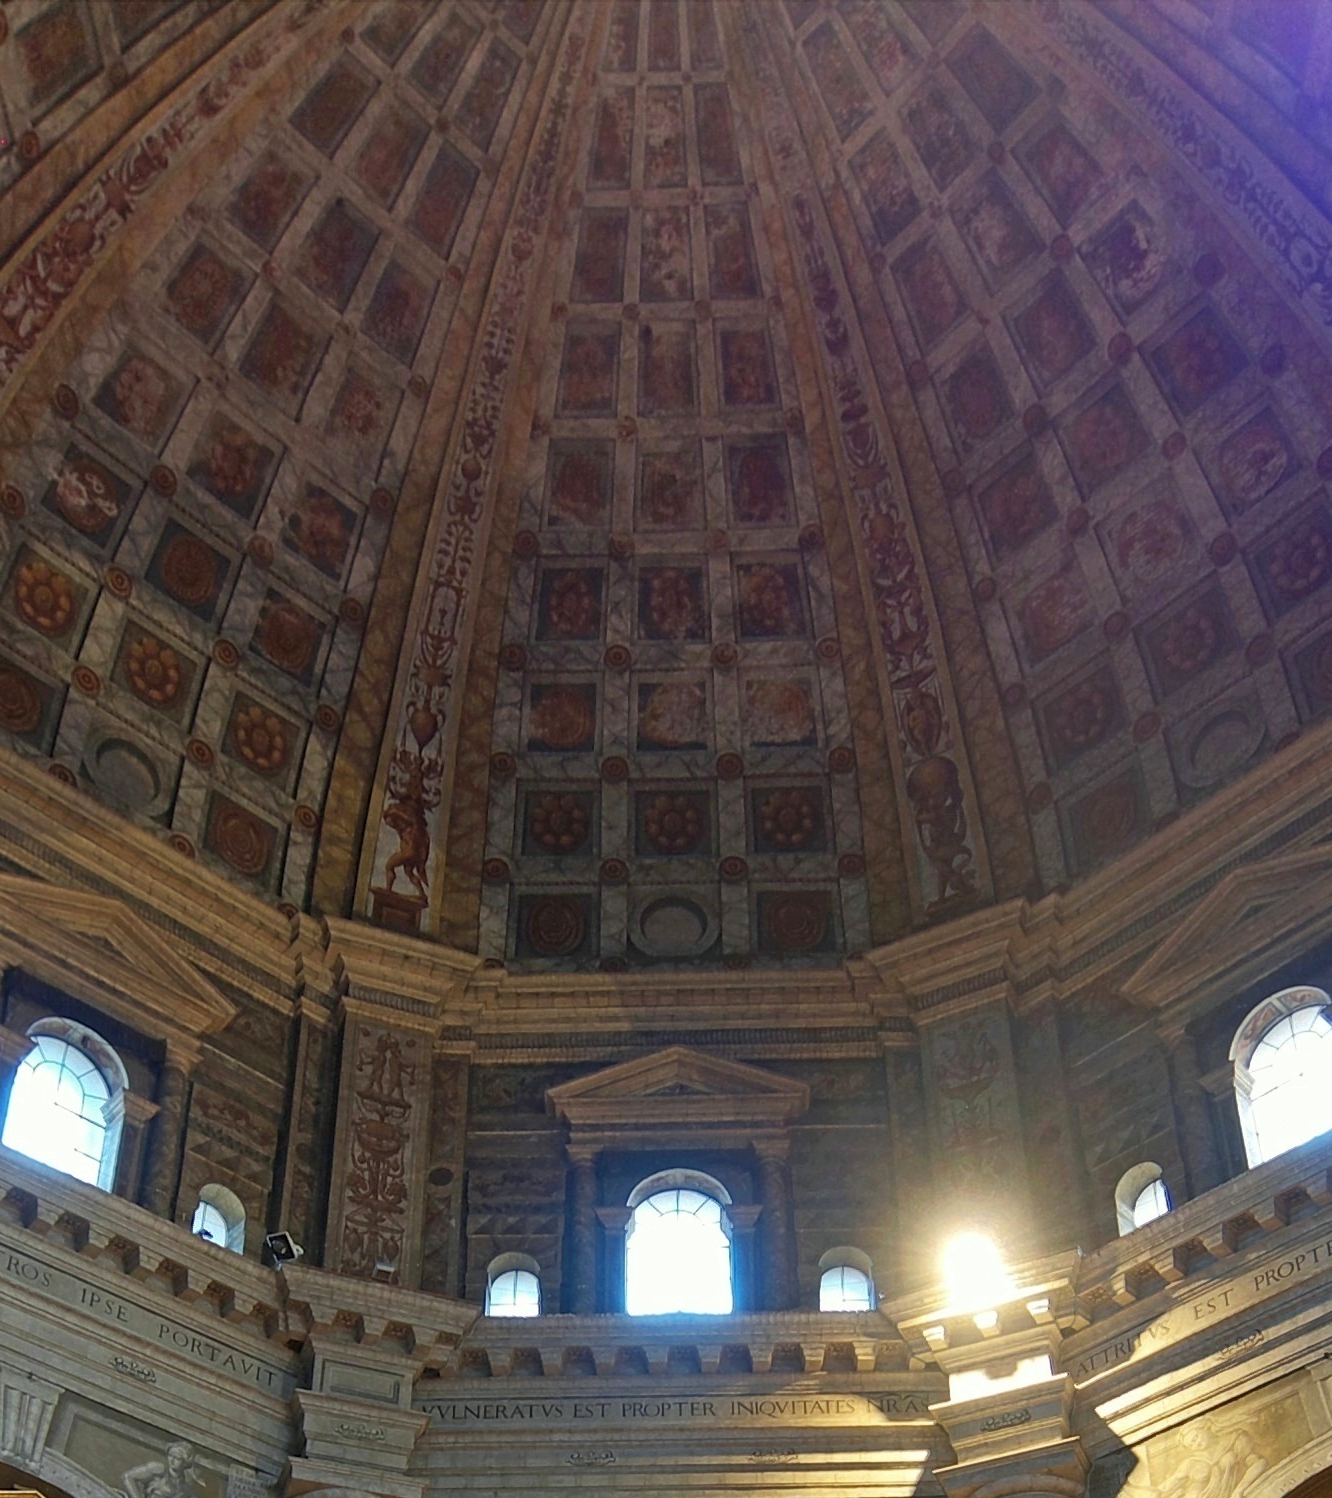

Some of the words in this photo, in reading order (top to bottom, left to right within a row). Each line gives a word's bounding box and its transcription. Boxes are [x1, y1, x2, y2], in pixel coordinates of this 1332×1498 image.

[80, 1287, 130, 1324] IPSE
[157, 1323, 279, 1386] PORTAVIT
[1075, 1319, 1171, 1377] ATTRITVS
[1193, 1287, 1235, 1321] EST
[572, 1402, 612, 1418] EST
[621, 1401, 717, 1418] PROPTER
[730, 1399, 856, 1418] INIQVITATES
